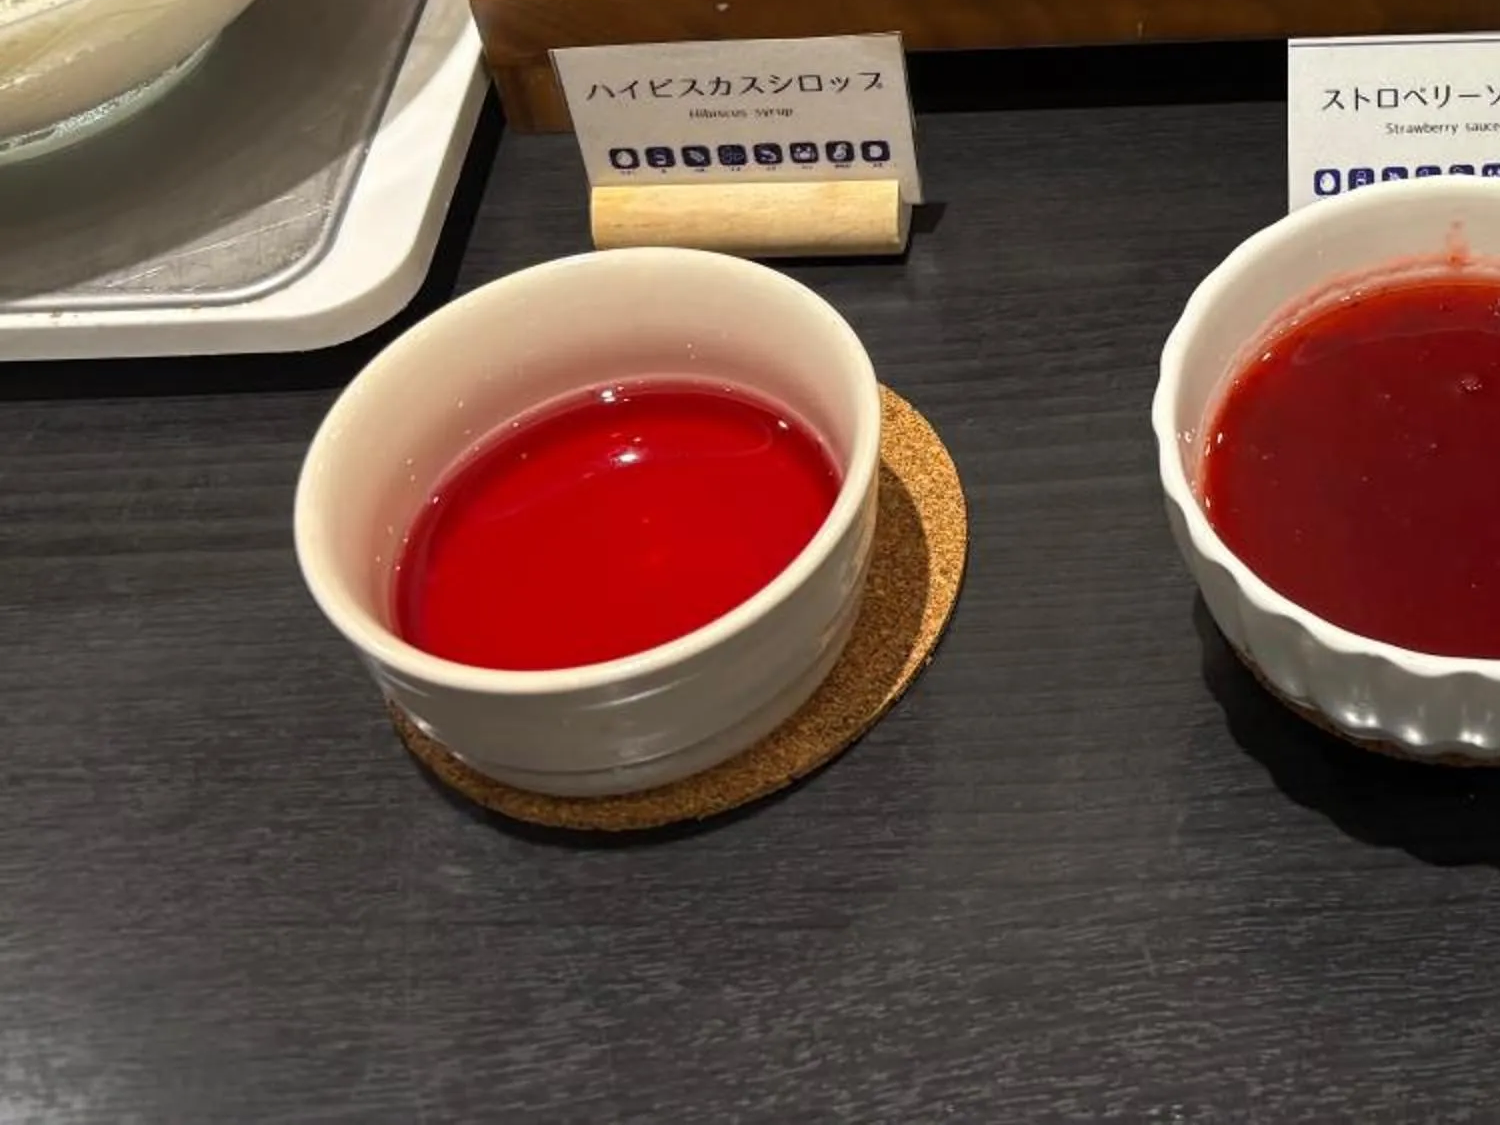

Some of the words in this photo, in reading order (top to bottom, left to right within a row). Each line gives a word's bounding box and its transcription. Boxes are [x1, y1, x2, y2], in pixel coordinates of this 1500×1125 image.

[586, 71, 885, 101] ハイビスカスシロップ
[1385, 122, 1459, 135] Strawberry
[1465, 121, 1500, 133] sauce
